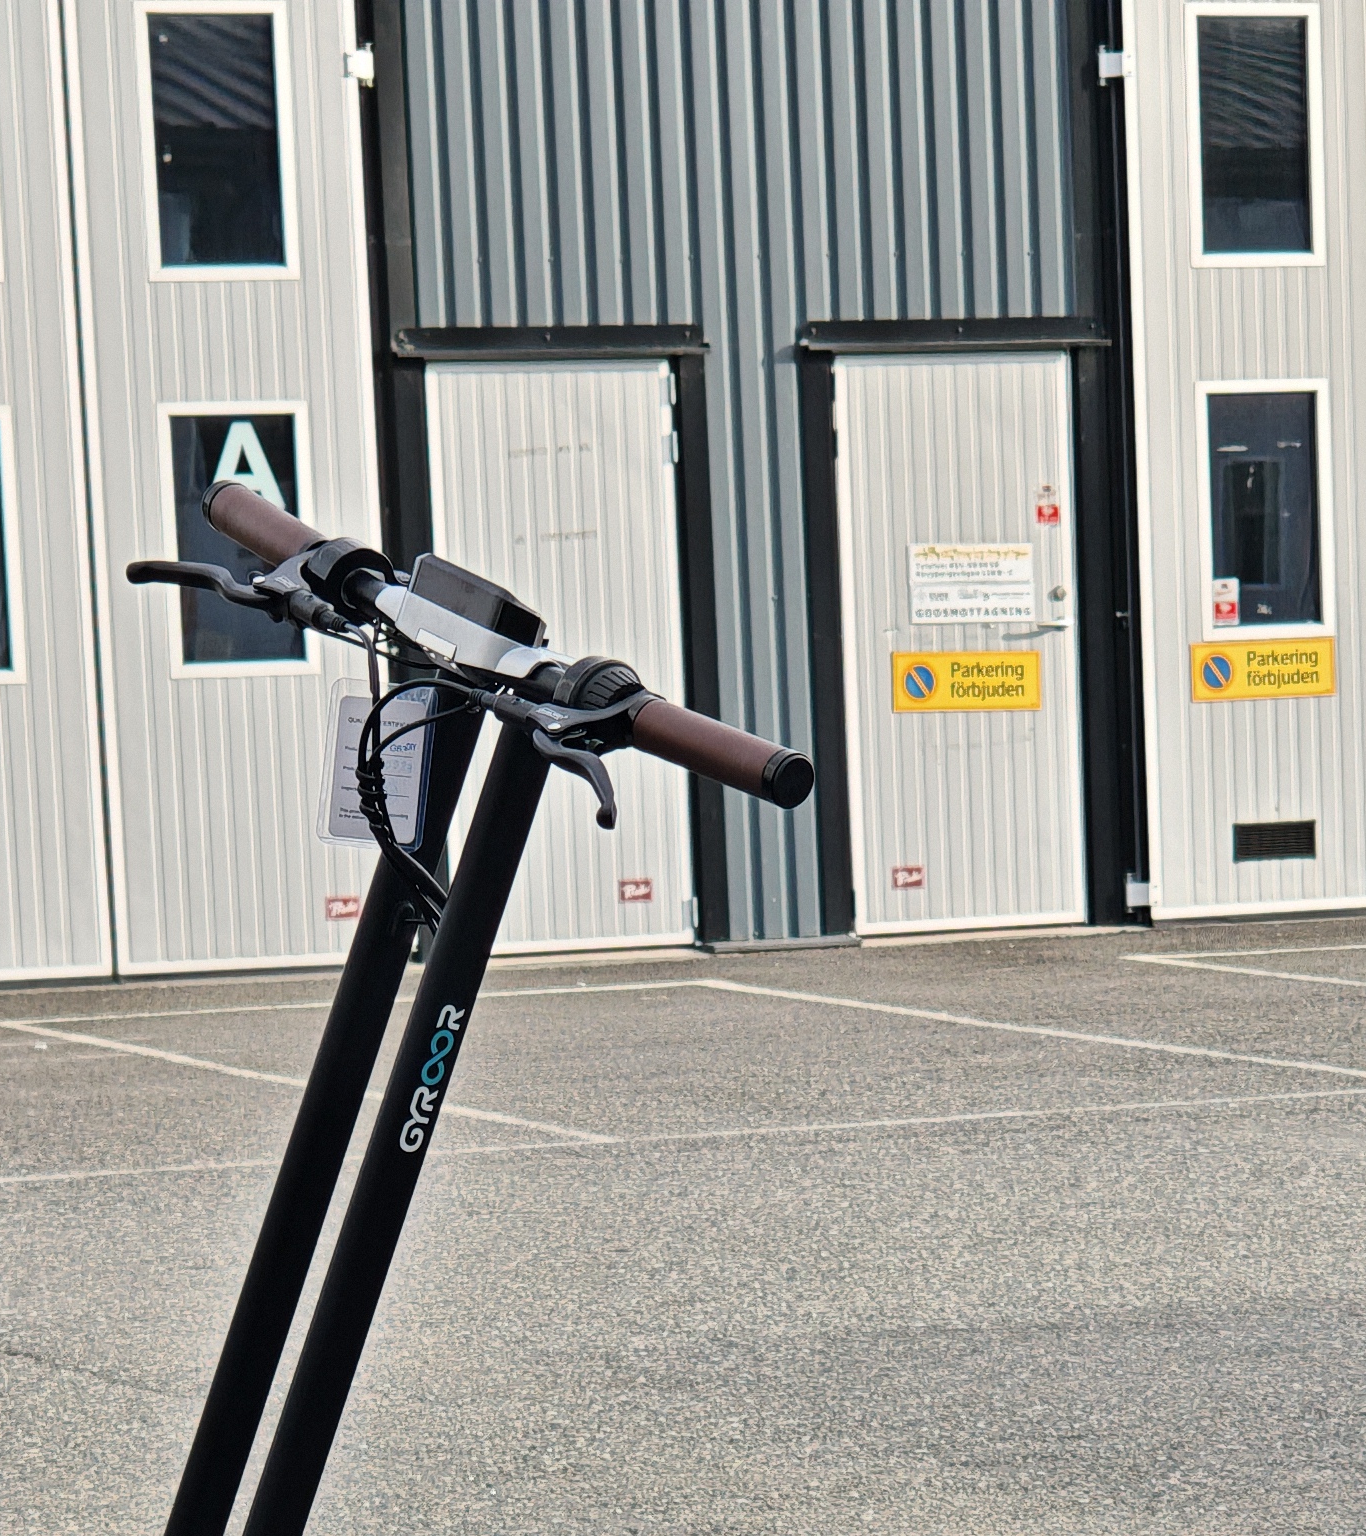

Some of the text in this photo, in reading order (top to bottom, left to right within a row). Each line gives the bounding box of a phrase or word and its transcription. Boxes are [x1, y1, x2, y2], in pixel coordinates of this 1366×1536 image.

[213, 421, 285, 511] A
[1247, 649, 1319, 668] Parkering
[950, 661, 1025, 681] Parkering
[1246, 669, 1319, 689] förbjuden
[950, 681, 1025, 701] förbjuden
[399, 1004, 466, 1153] GYROOR
